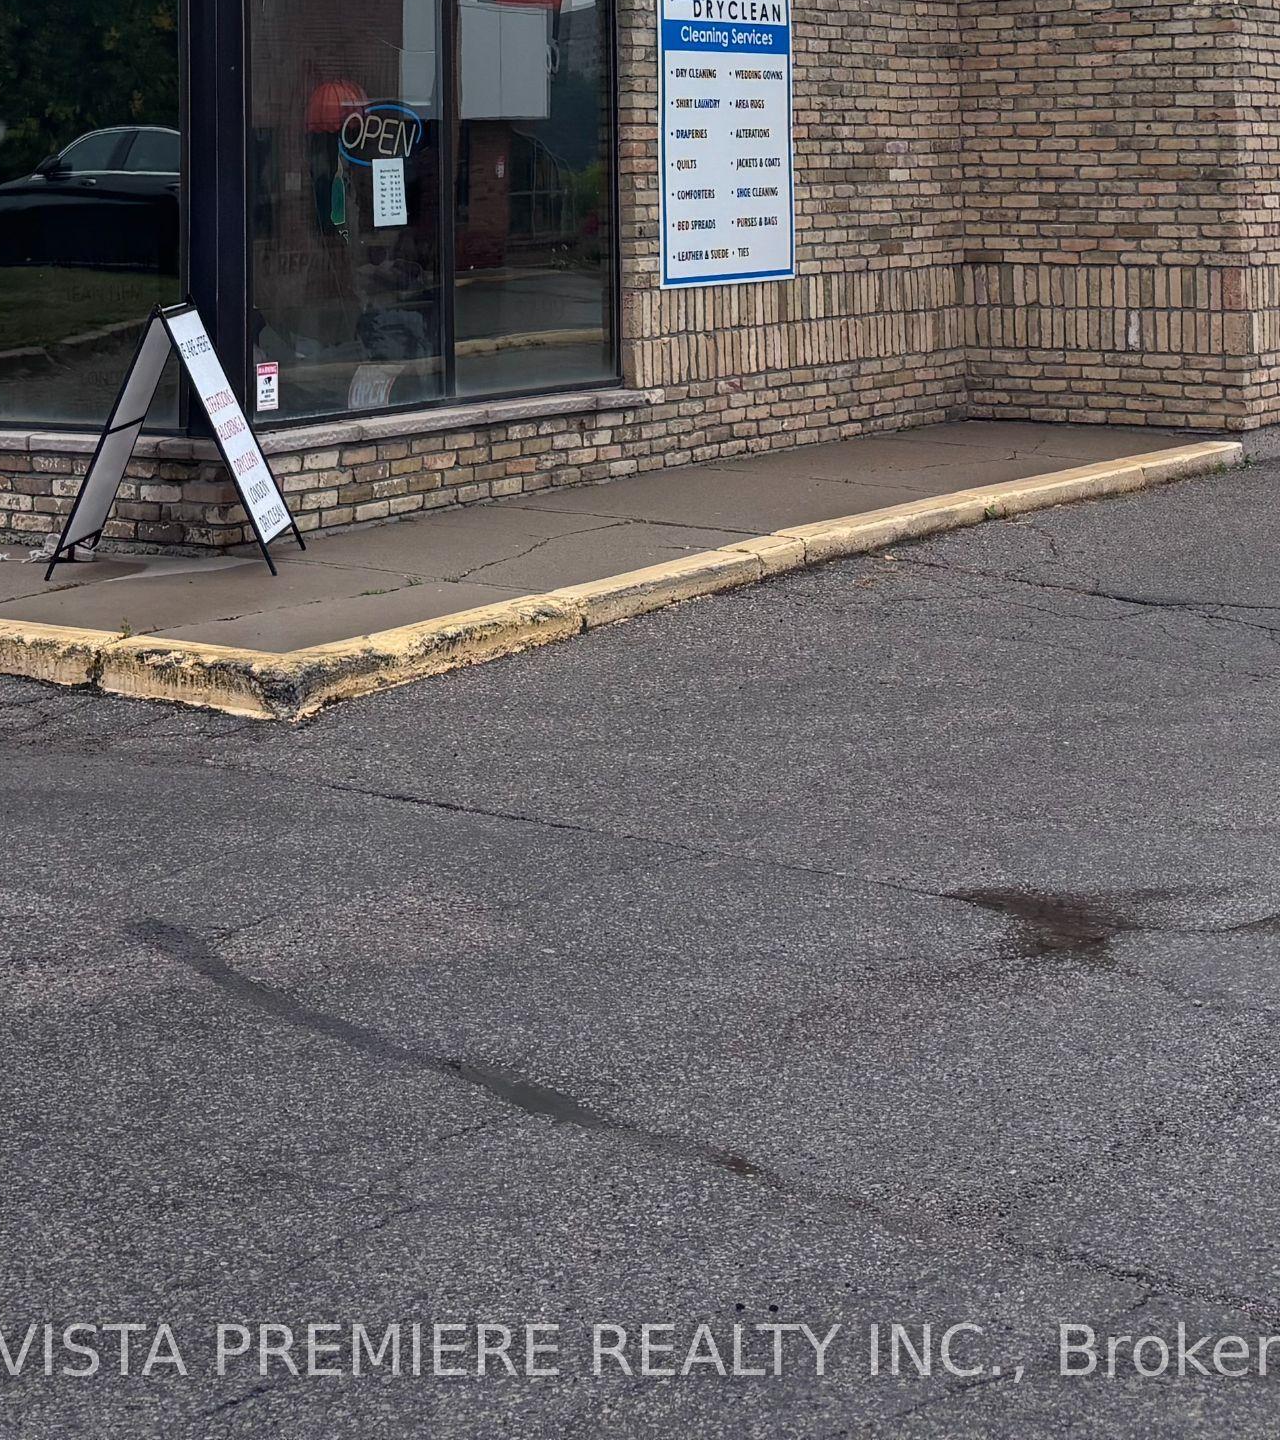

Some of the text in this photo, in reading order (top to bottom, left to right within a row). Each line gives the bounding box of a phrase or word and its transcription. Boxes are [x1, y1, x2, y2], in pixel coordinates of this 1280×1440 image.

[693, 0, 781, 23] DRYCLEAN
[680, 25, 773, 48] Cleaning Services
[675, 68, 717, 79] DRY CLEANING
[735, 69, 783, 81] WEDDING GOWNS
[675, 98, 720, 109] SHIRT LAUNDRY
[735, 99, 765, 109] AREA RUGS
[341, 112, 417, 158] OPEN
[675, 128, 708, 139] DRAPERIES
[735, 128, 770, 139] ALTERATIONS
[676, 159, 697, 171] QUILTS
[736, 158, 758, 170] JACKETS
[764, 157, 781, 168] COATS
[677, 189, 715, 200] COMFORTERS
[736, 186, 779, 198] SHOE CLEANING
[677, 219, 716, 231] BED SPREADS
[736, 217, 758, 228] PURSES
[764, 216, 778, 226] BAGS
[677, 250, 704, 262] LEATHER
[710, 248, 729, 260] SUEDE
[737, 247, 750, 258] TIES
